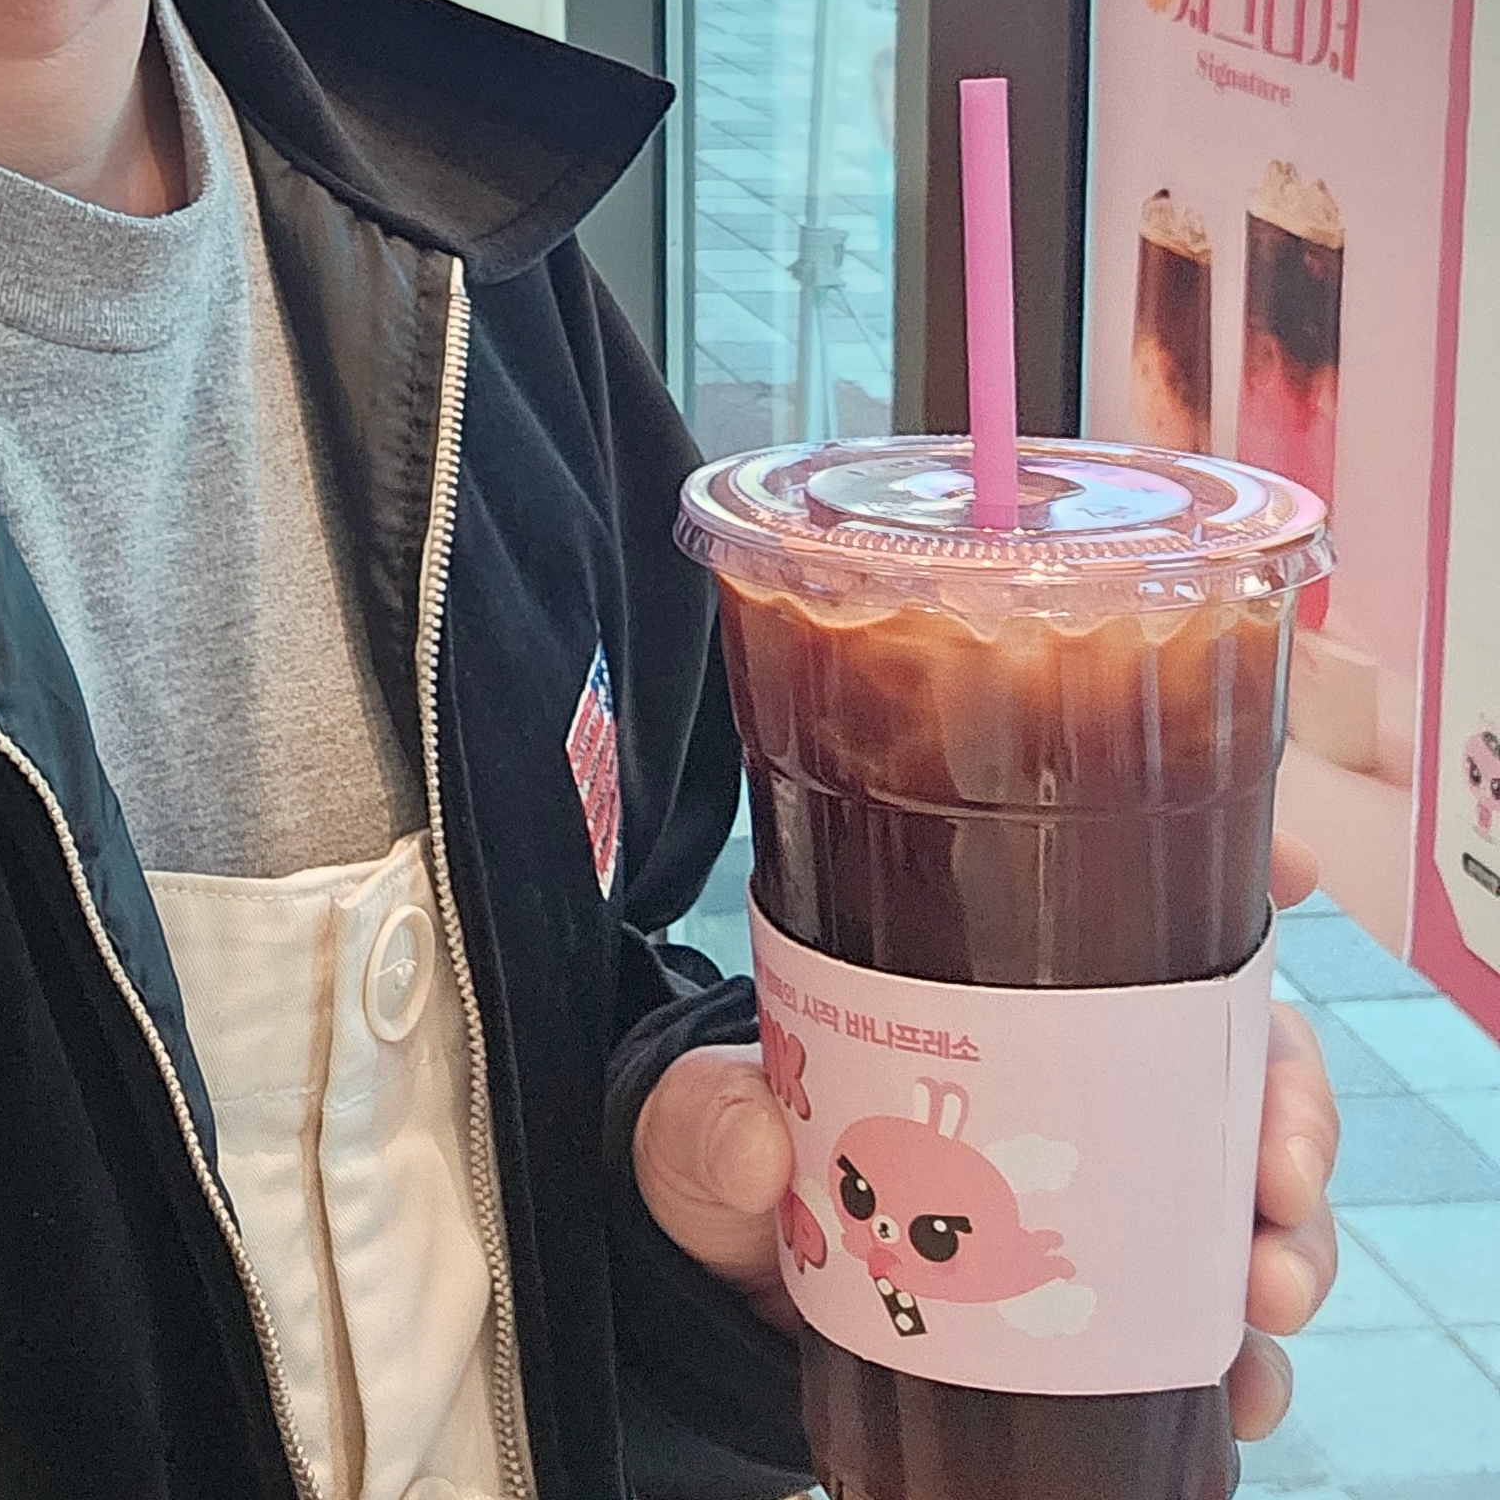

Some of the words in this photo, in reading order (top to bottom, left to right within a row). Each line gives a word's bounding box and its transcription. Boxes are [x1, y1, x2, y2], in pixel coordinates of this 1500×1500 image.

[1197, 50, 1291, 106] Signature
[802, 993, 840, 1033] 시작
[846, 1009, 982, 1062] 바나프레소
